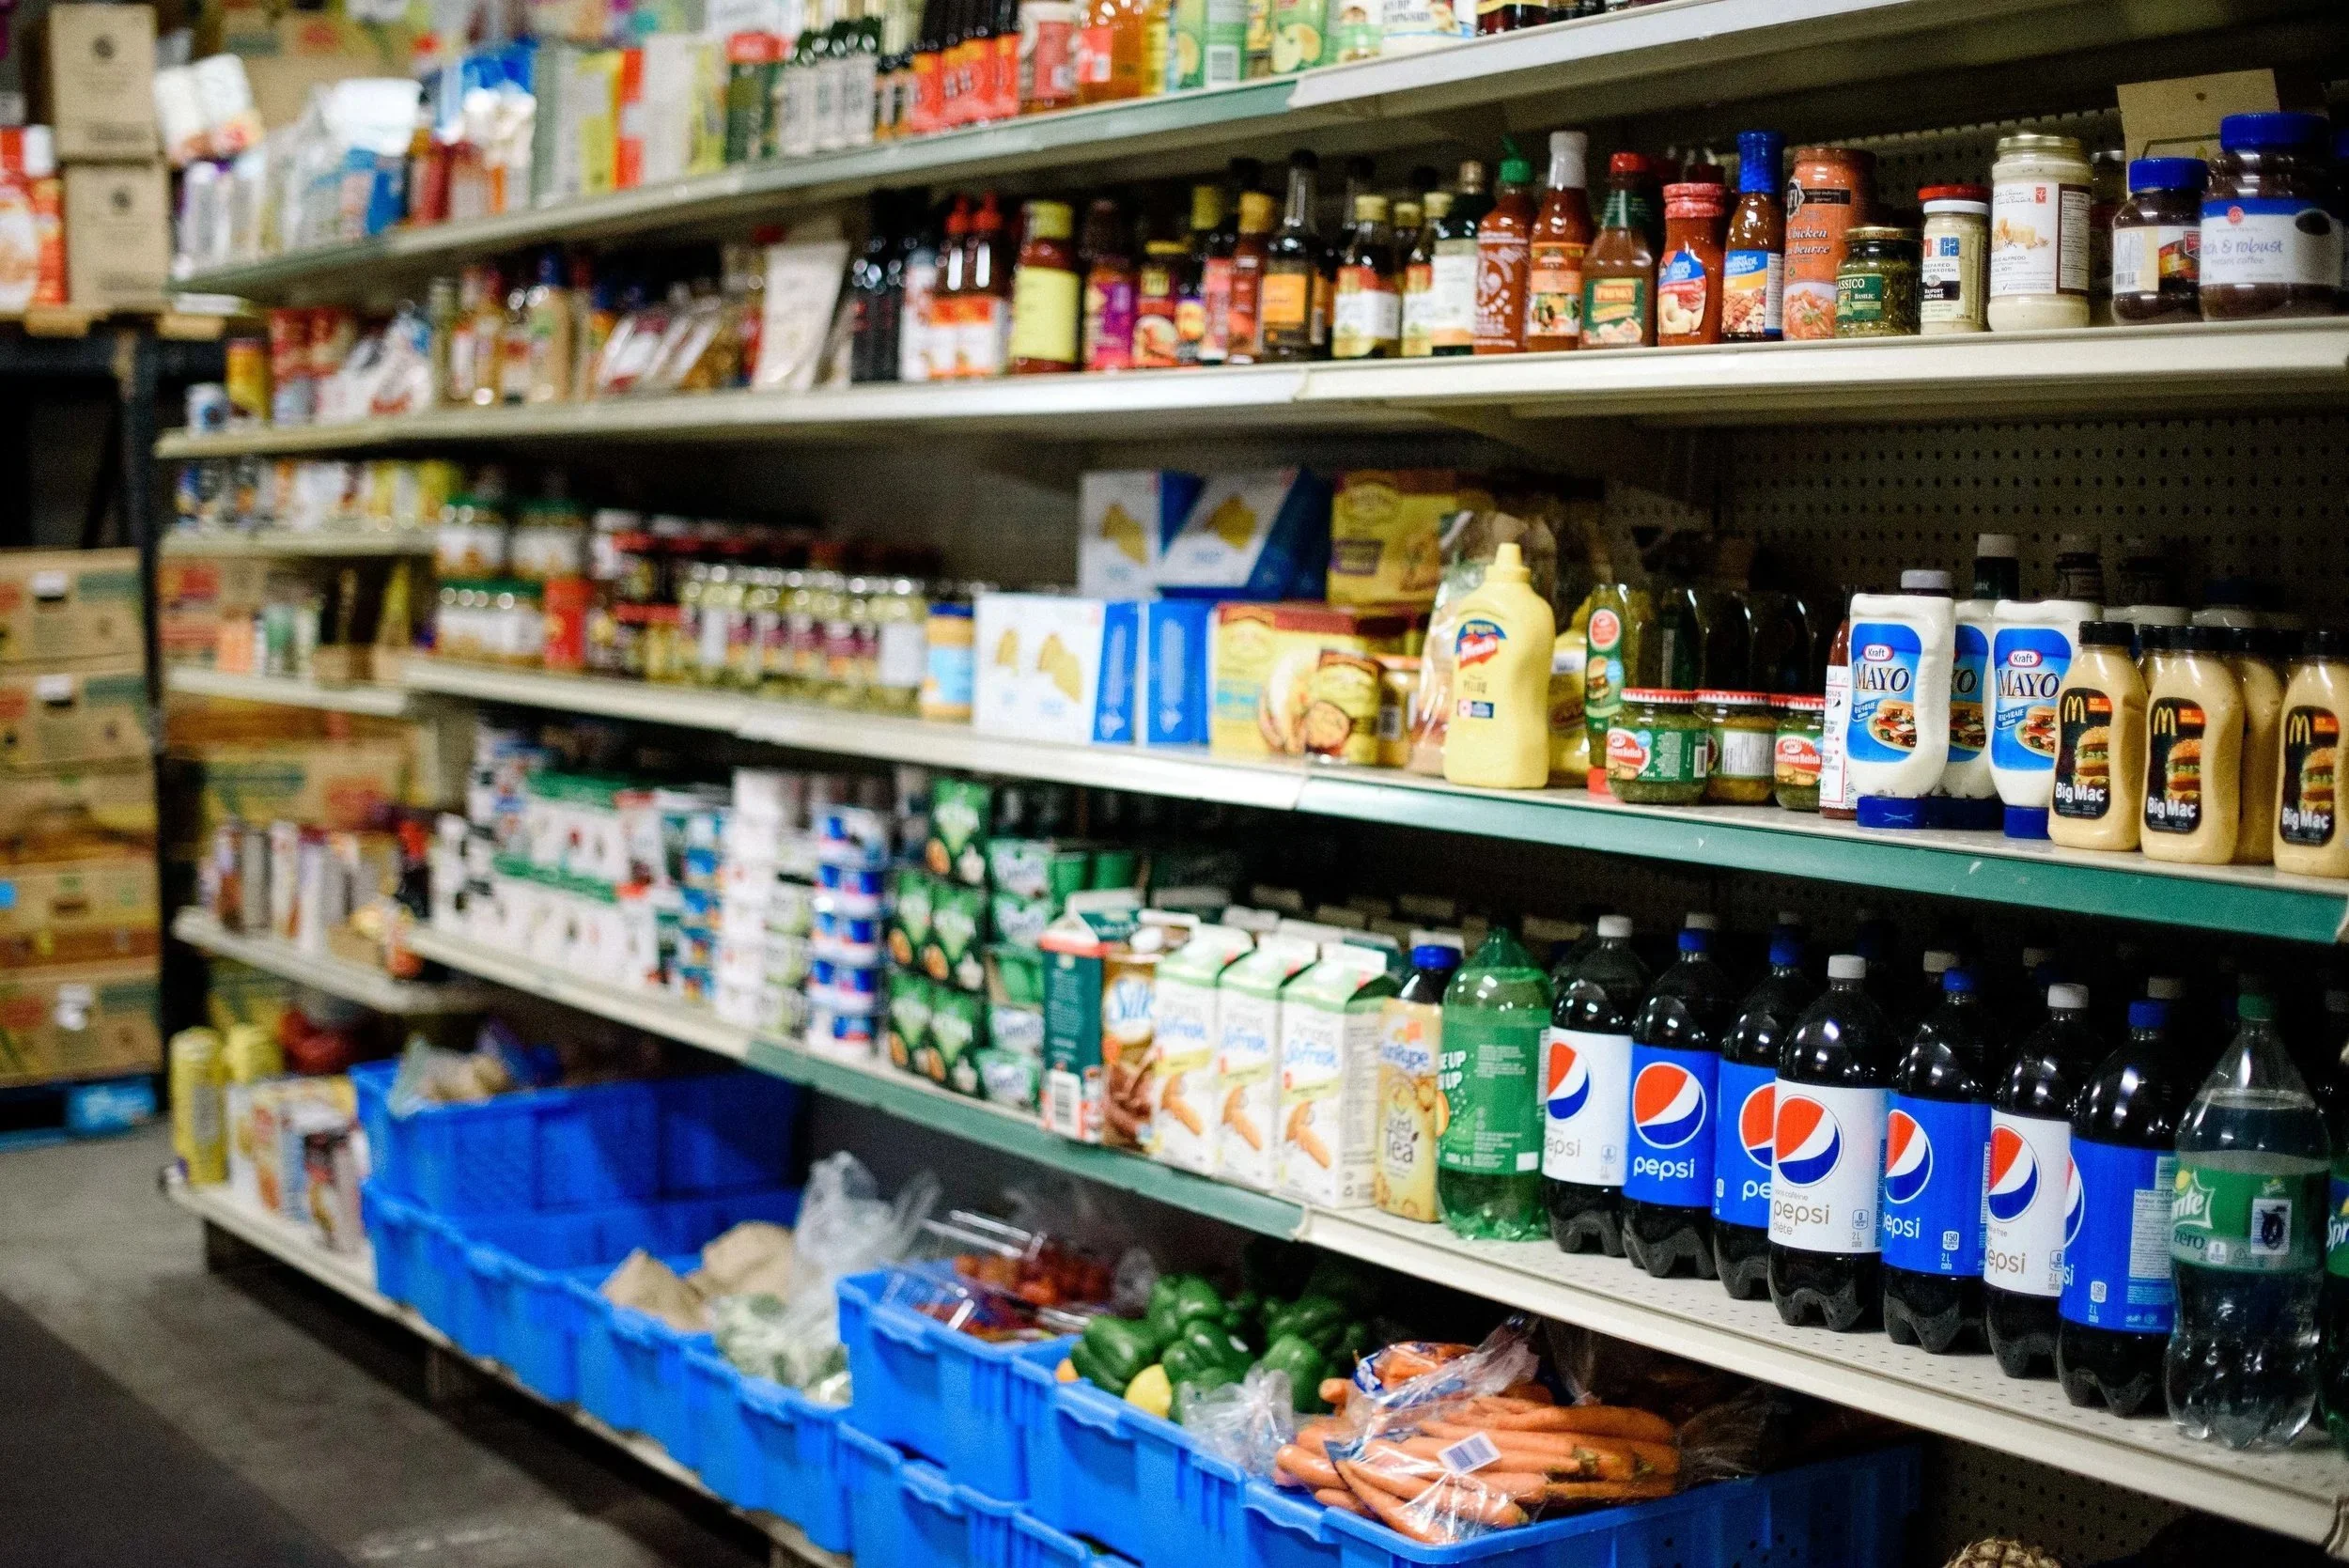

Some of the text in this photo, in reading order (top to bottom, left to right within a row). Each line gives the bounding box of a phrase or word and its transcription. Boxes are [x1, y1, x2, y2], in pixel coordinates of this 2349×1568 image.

[2236, 237, 2283, 254] robust
[1838, 277, 1865, 291] ASSICO
[1868, 646, 1886, 658] Kraft
[2014, 652, 2032, 663] Kraft
[1855, 663, 1910, 692] MAYO
[1997, 669, 2060, 699] MAYO
[2055, 782, 2105, 802] Big Mac
[2147, 796, 2197, 818] Big Mac
[2281, 807, 2330, 830] Big Mac
[1449, 1050, 1466, 1069] UP
[1545, 1135, 1581, 1157] epsi
[1633, 1157, 1695, 1182] pepsi
[1774, 1200, 1830, 1226] pepsi
[2172, 1188, 2205, 1220] rite
[1945, 1233, 1958, 1241] 150
[2173, 1228, 2206, 1250] zero
[2326, 1215, 2349, 1253] Spr
[1986, 1247, 2026, 1274] epsi
[2092, 1283, 2105, 1293] 150
